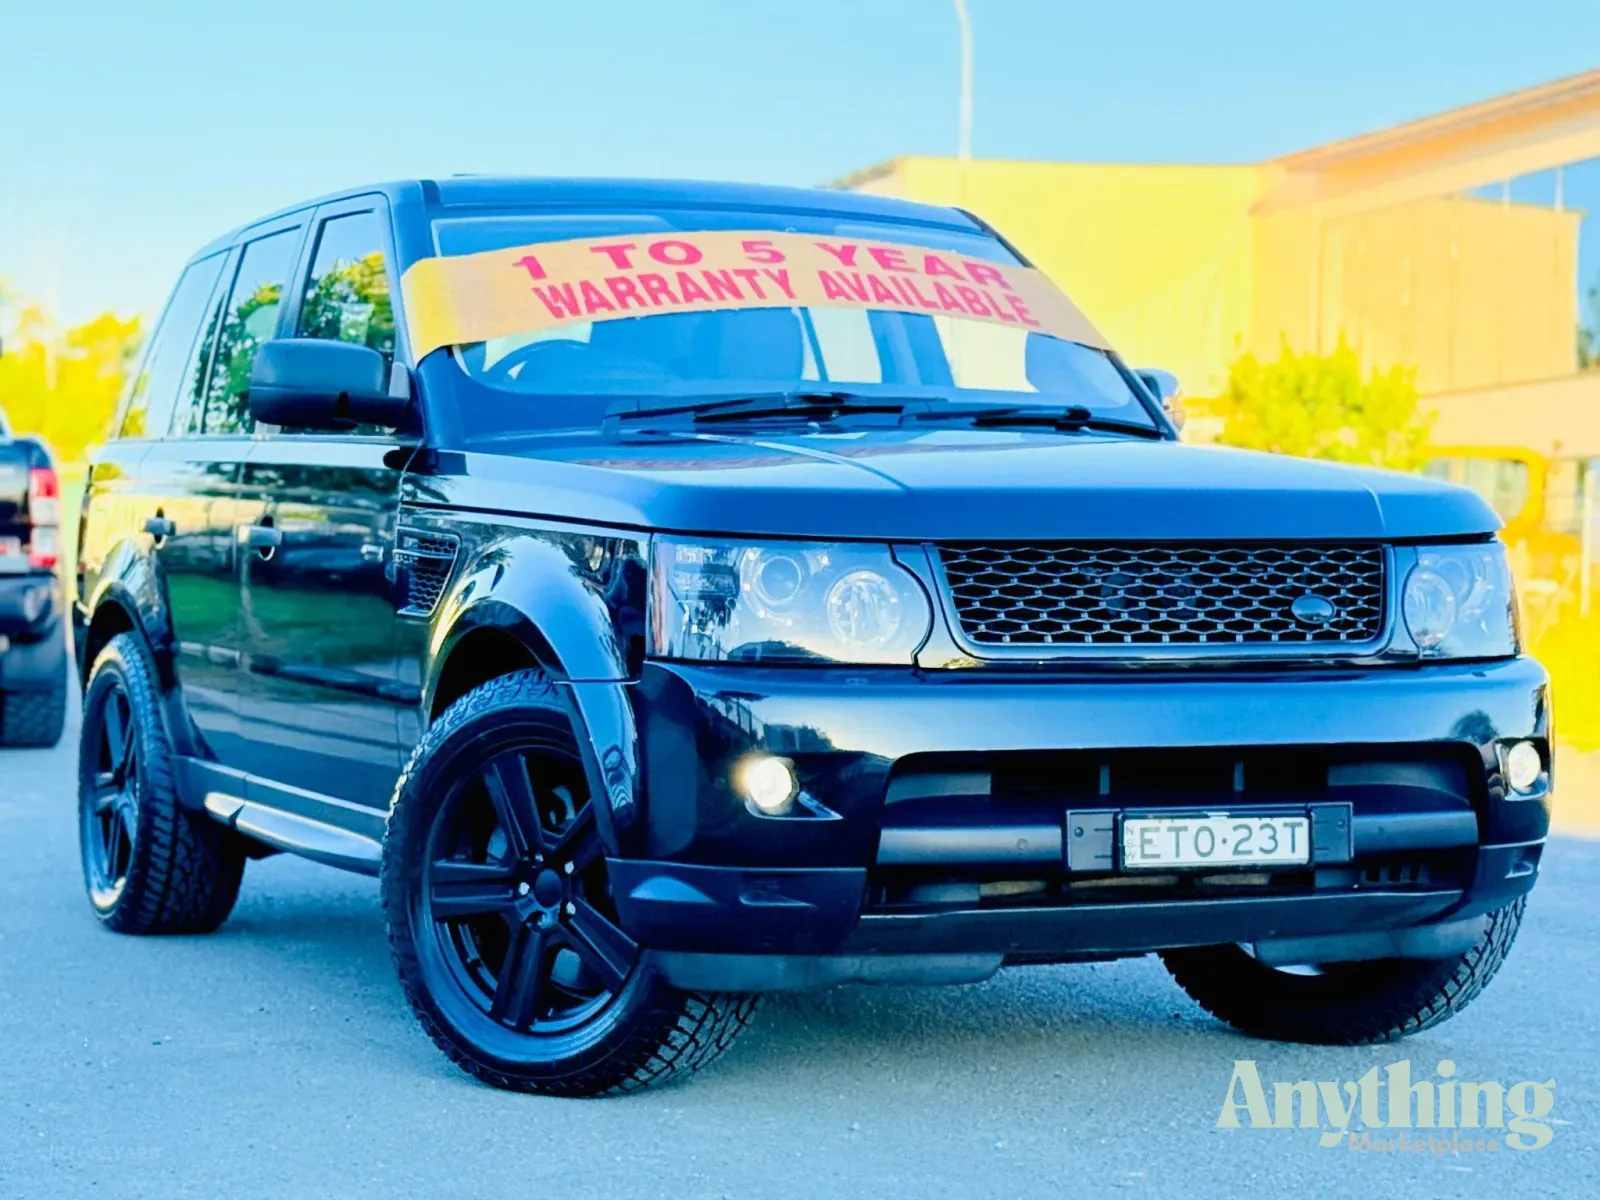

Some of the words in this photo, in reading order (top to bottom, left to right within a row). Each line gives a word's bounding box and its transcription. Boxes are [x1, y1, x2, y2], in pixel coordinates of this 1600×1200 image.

[512, 255, 547, 281] 1
[589, 239, 703, 270] TO
[741, 240, 786, 265] 5
[813, 242, 1013, 290] YEAR
[532, 268, 797, 319] WARRANTY
[817, 270, 1041, 328] AVAILABLE
